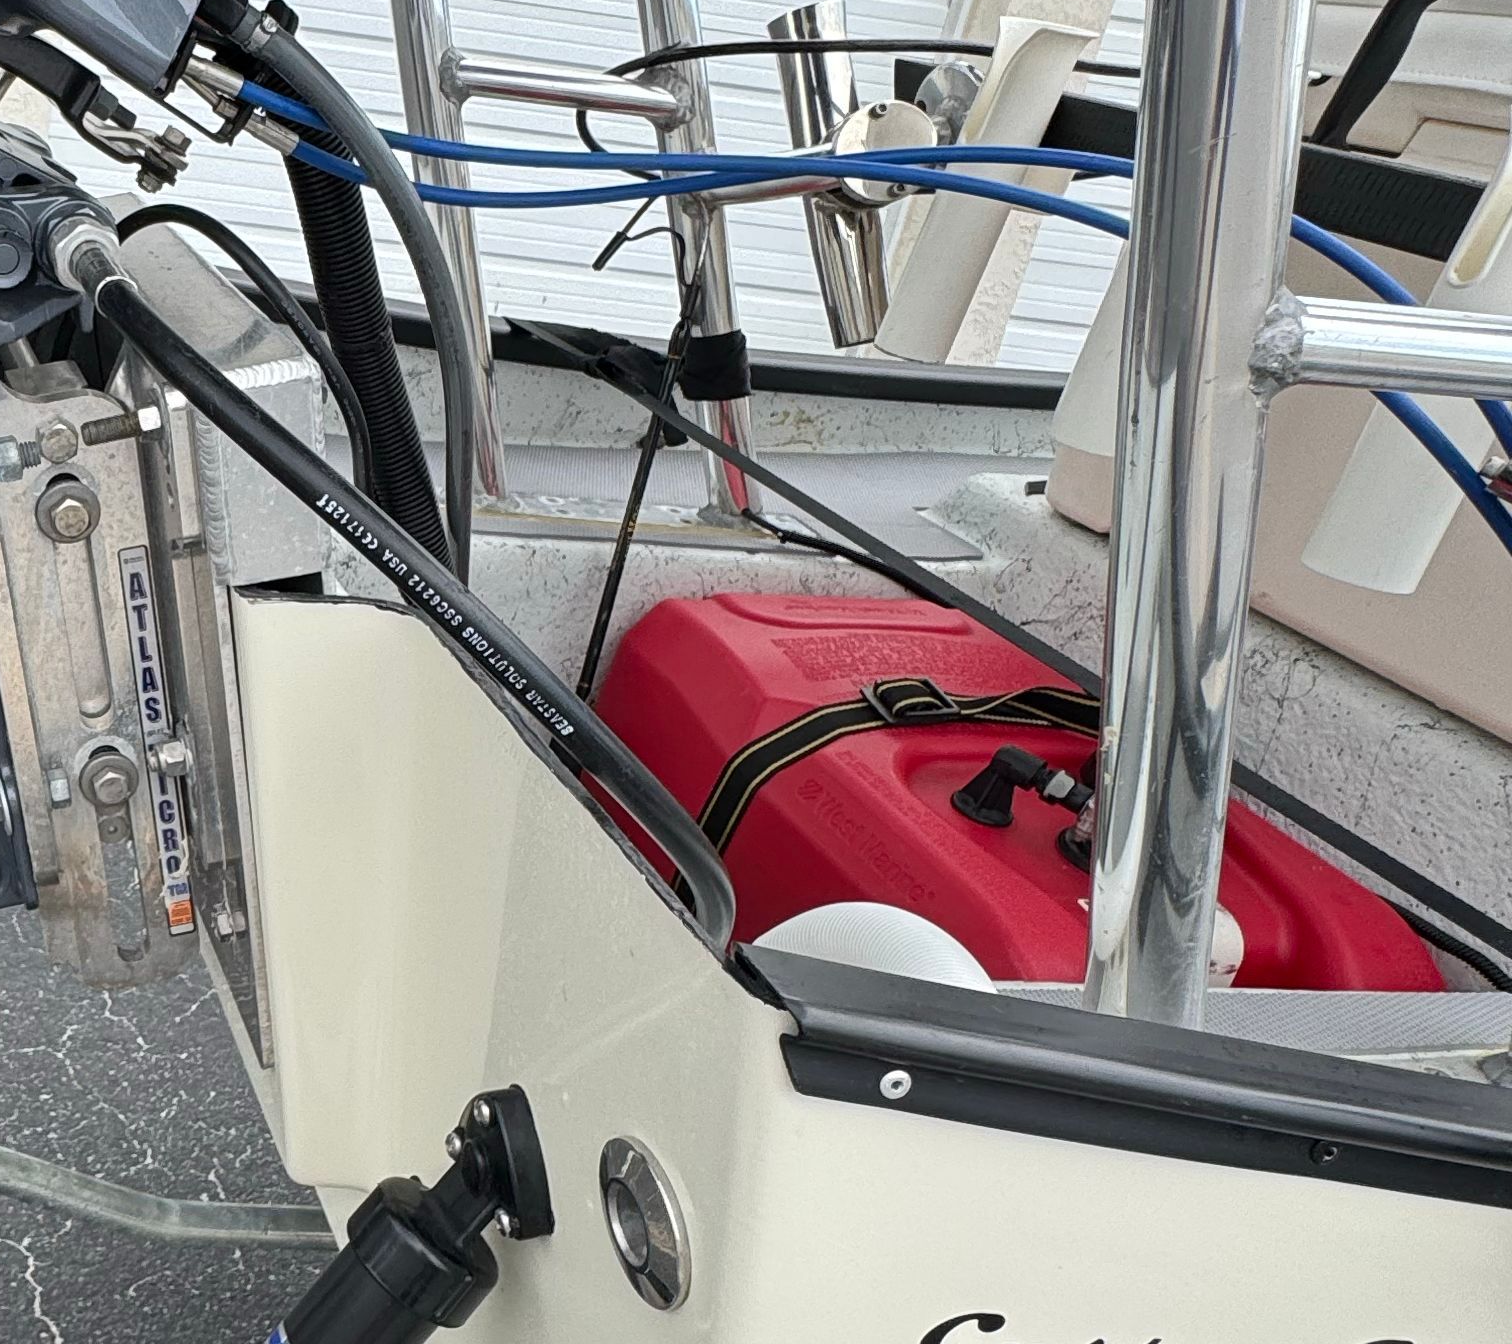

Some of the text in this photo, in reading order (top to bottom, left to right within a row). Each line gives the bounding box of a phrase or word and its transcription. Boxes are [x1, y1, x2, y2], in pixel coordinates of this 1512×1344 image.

[382, 549, 407, 577] USA
[408, 573, 464, 627] SSC6212
[129, 572, 162, 723] ATLAS
[463, 626, 528, 689] SOLUTIONS
